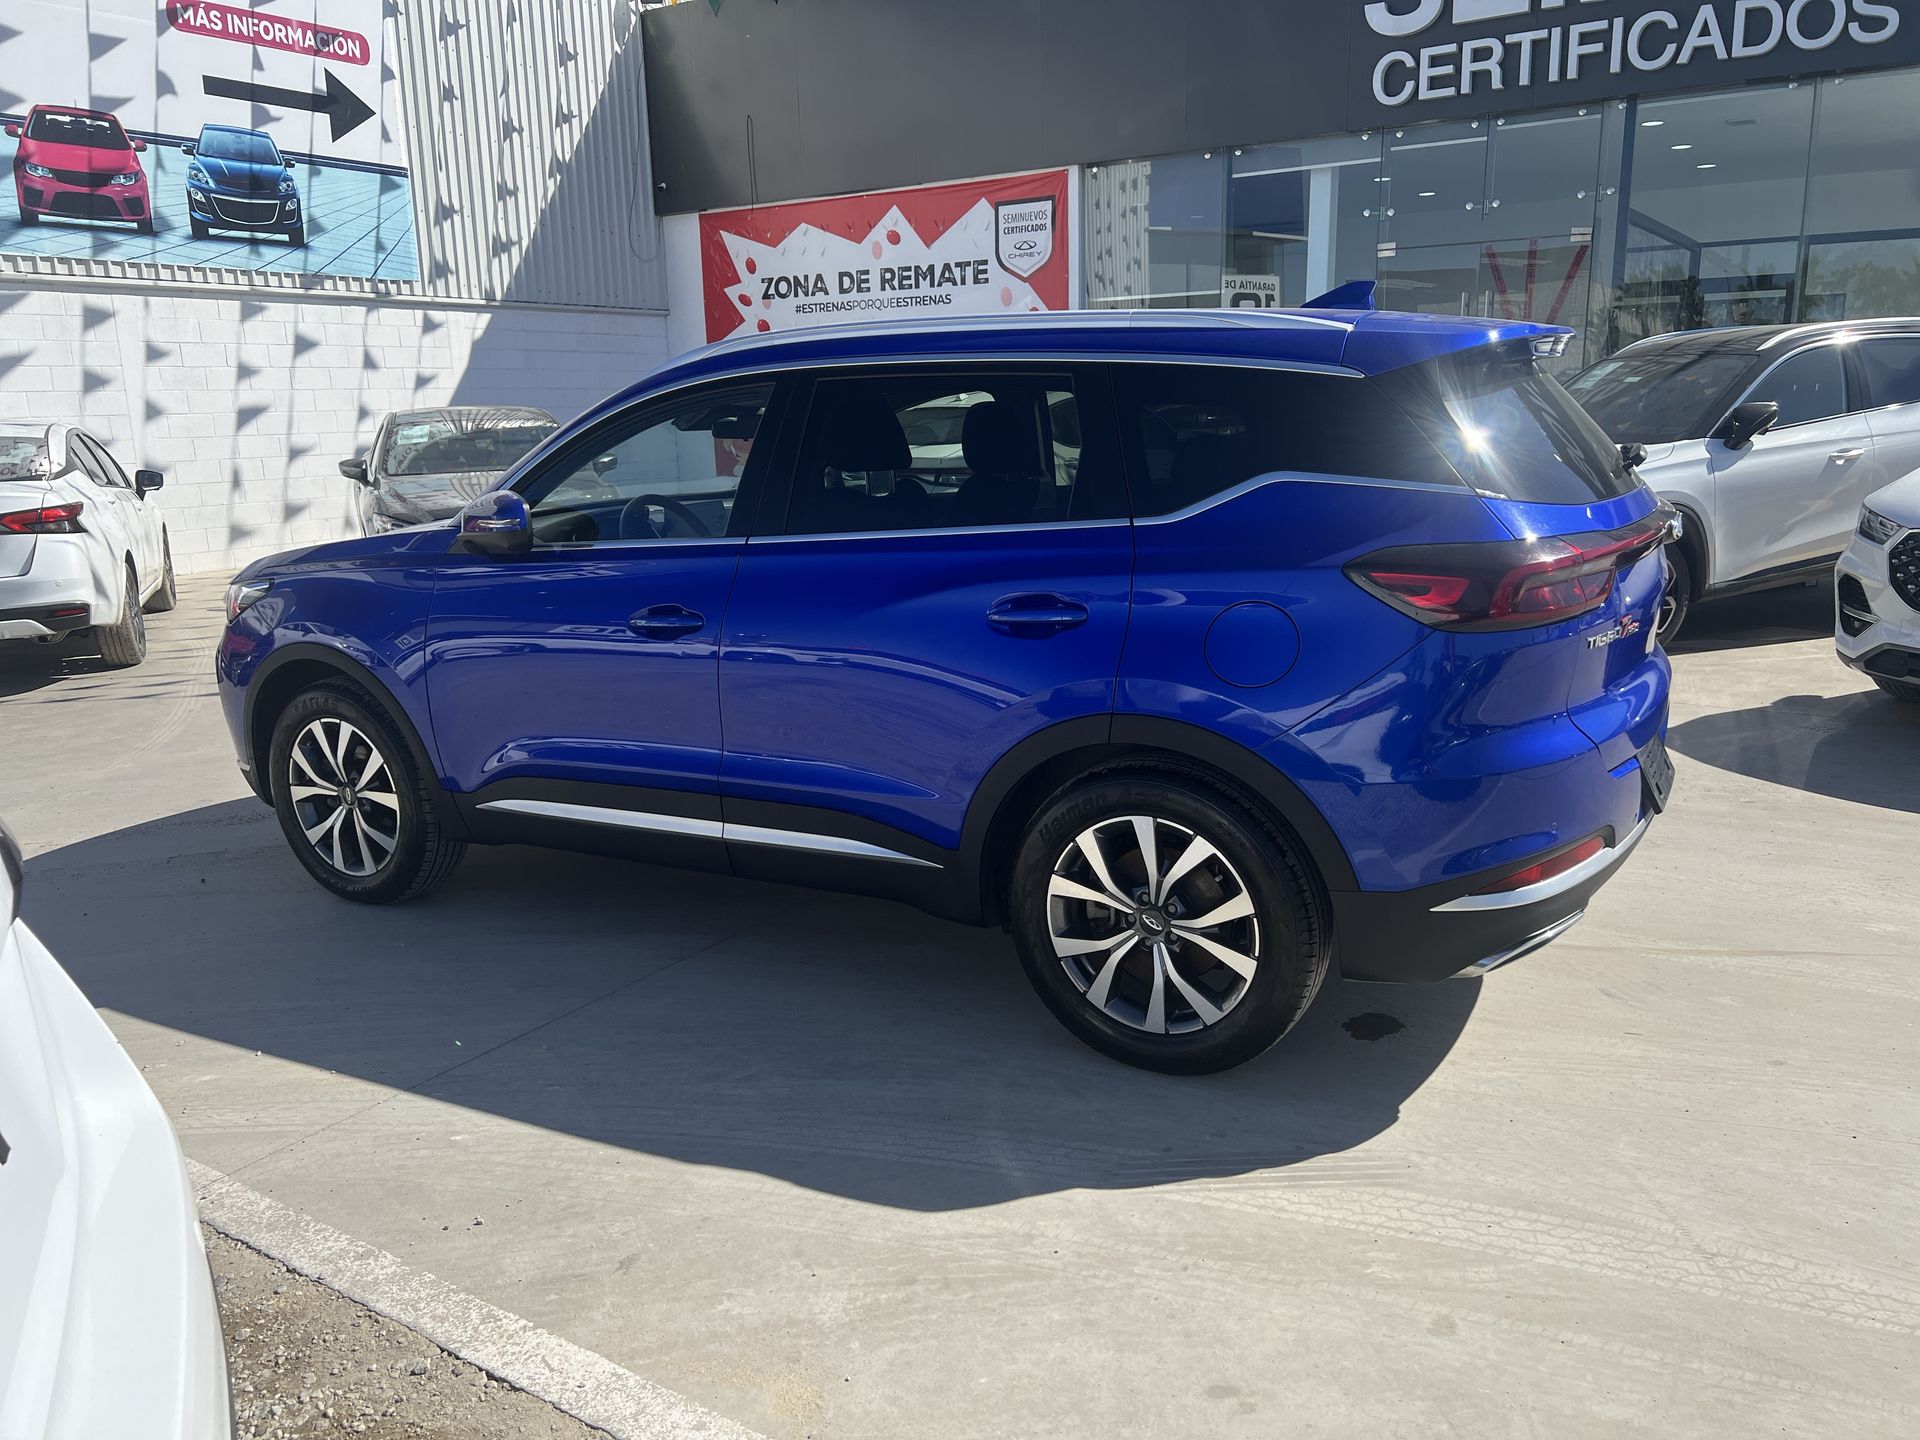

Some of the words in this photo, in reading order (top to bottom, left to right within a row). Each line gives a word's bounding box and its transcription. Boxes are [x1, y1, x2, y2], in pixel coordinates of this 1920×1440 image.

[175, 1, 223, 31] MÁS
[226, 13, 362, 59] INFORMACIÓN
[1371, 0, 1901, 106] CERTIFICADOS
[1003, 210, 1048, 224] SEMINUEVOS
[1003, 223, 1047, 235] CERTIFICADOS
[761, 273, 829, 300] ZONA
[838, 269, 871, 295] DE
[880, 259, 989, 291] REMATE
[795, 293, 952, 314] #ESTRENASPORQUEESTRENAS
